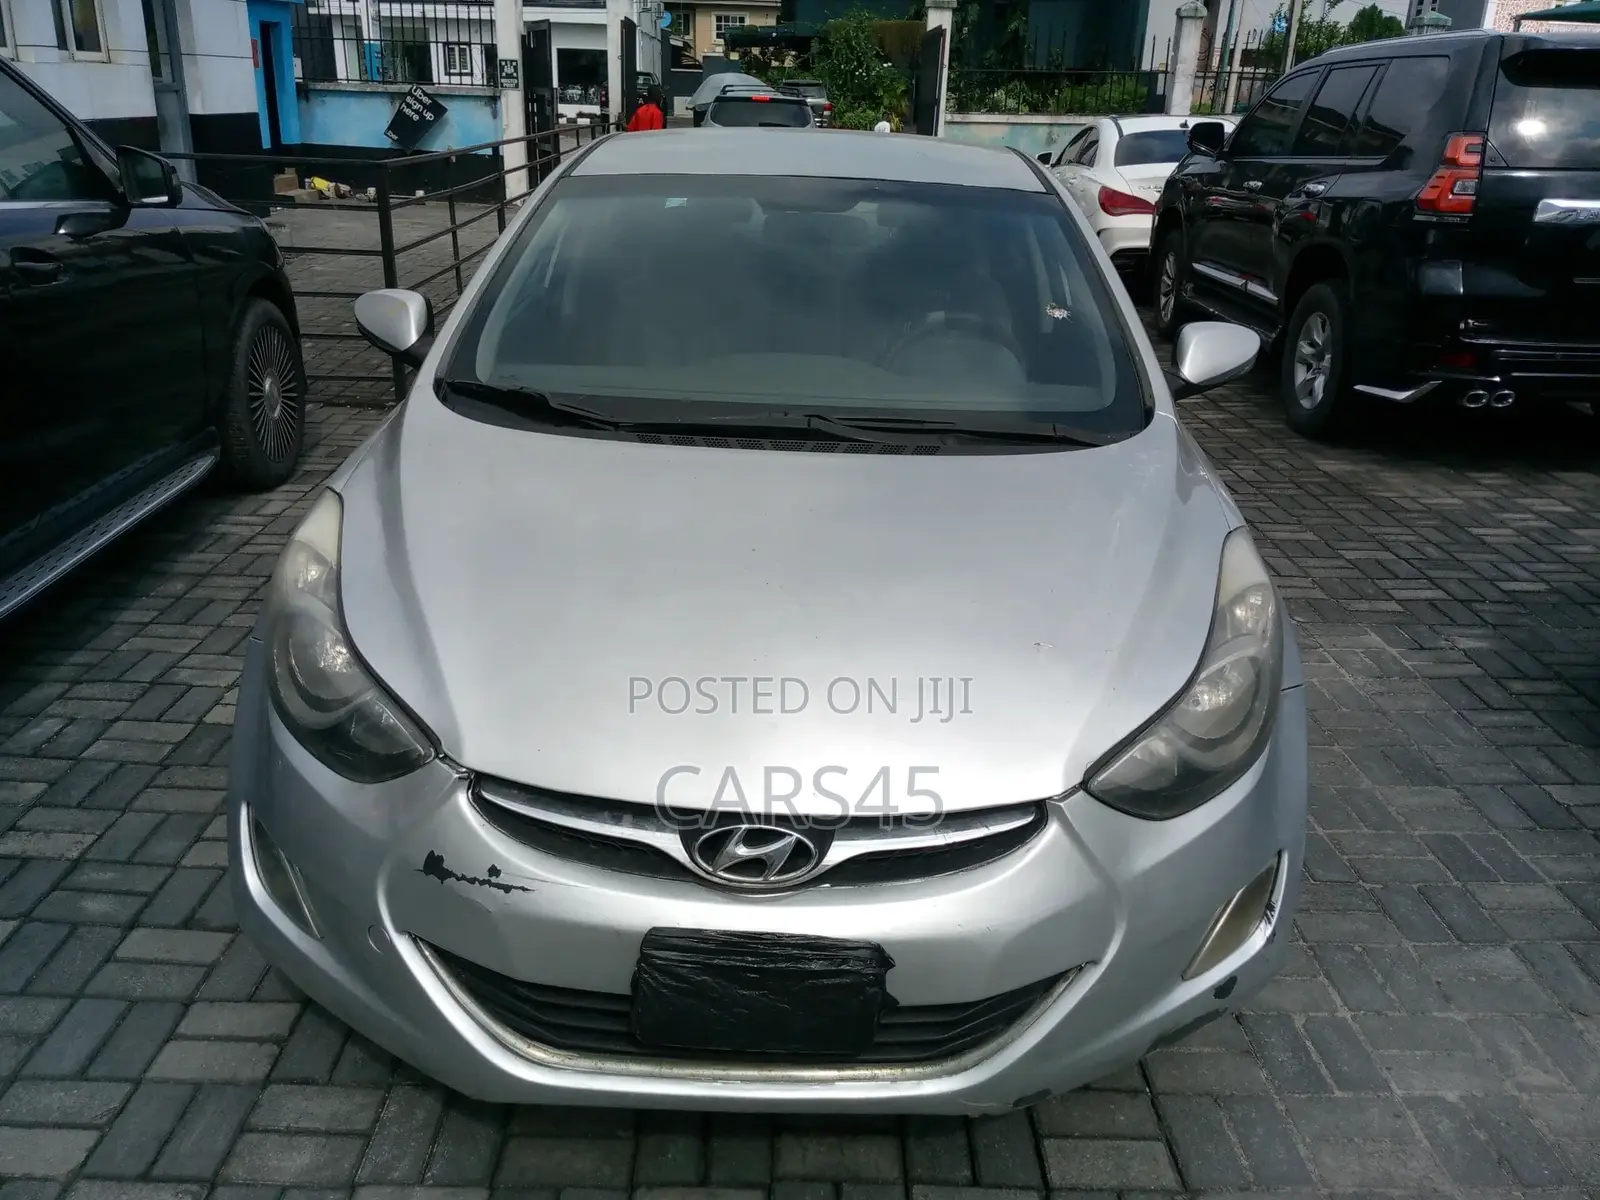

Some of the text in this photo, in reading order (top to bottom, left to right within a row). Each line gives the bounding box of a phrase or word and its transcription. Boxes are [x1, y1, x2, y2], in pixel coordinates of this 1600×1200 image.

[411, 84, 433, 106] Uber
[400, 102, 420, 122] here
[405, 95, 435, 121] sign up
